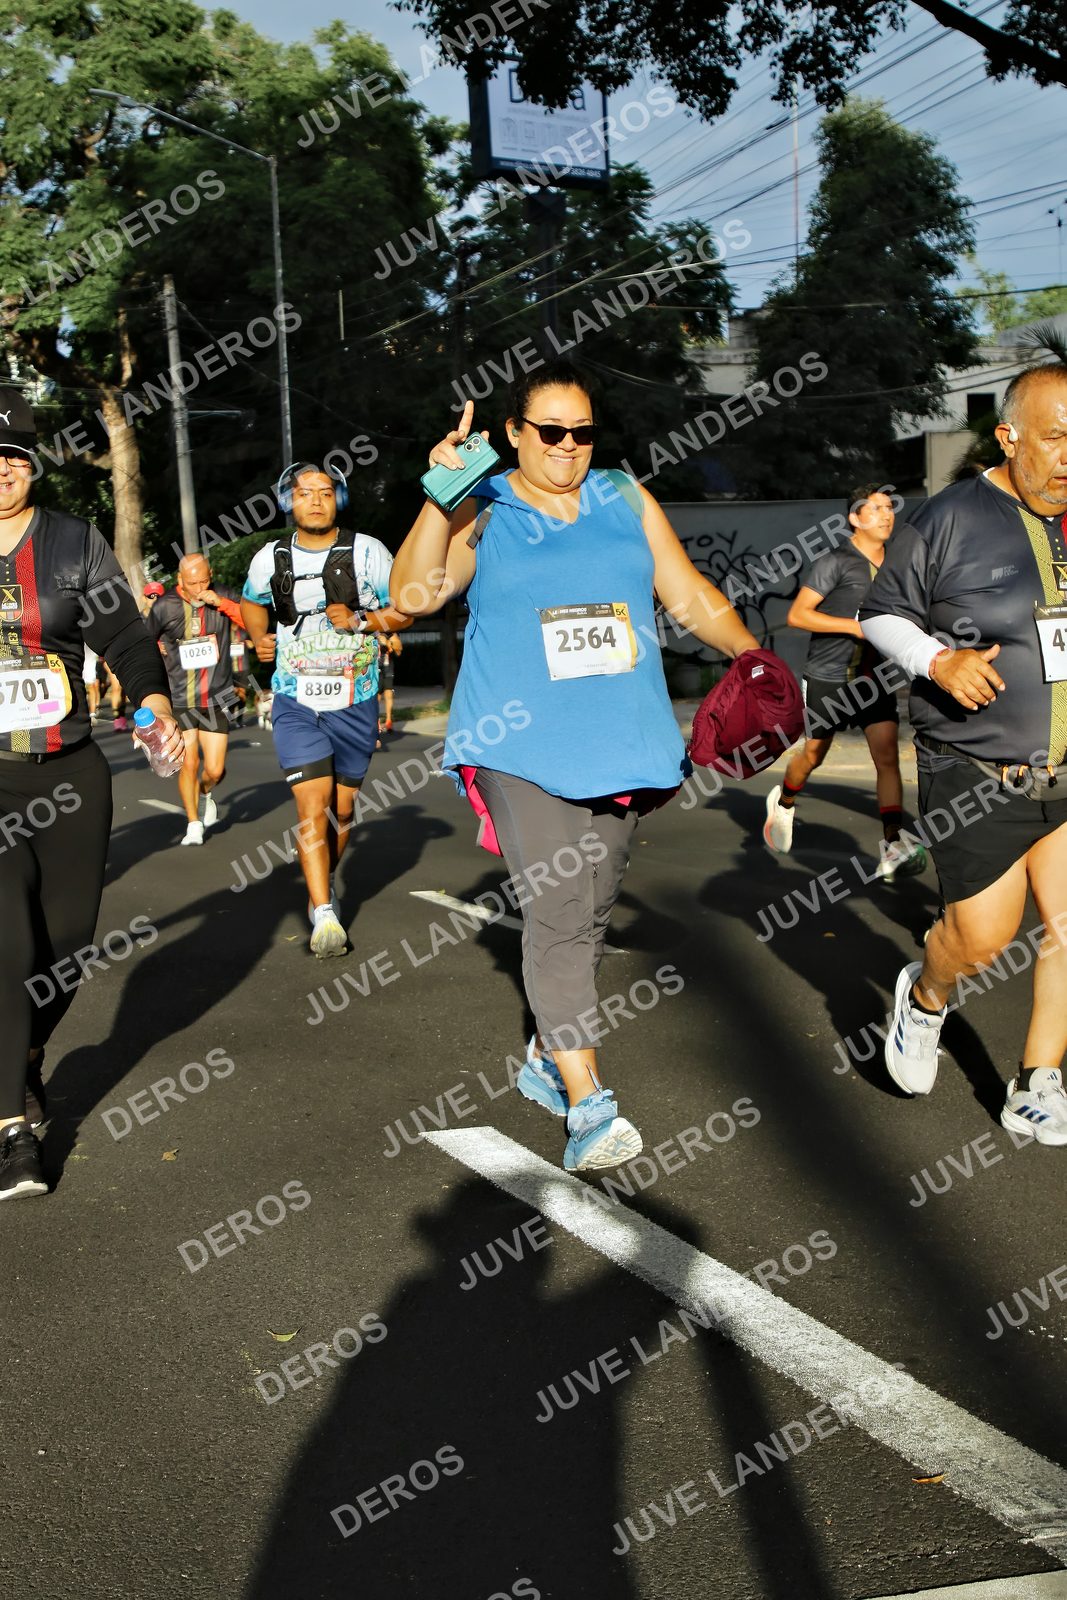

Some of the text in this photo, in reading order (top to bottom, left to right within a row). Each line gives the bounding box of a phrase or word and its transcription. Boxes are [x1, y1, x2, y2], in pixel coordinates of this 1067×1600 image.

[556, 626, 616, 652] 2564
[1053, 629, 1067, 651] 4
[183, 645, 213, 659] 10263
[0, 678, 49, 706] 701
[305, 682, 342, 696] 8309
